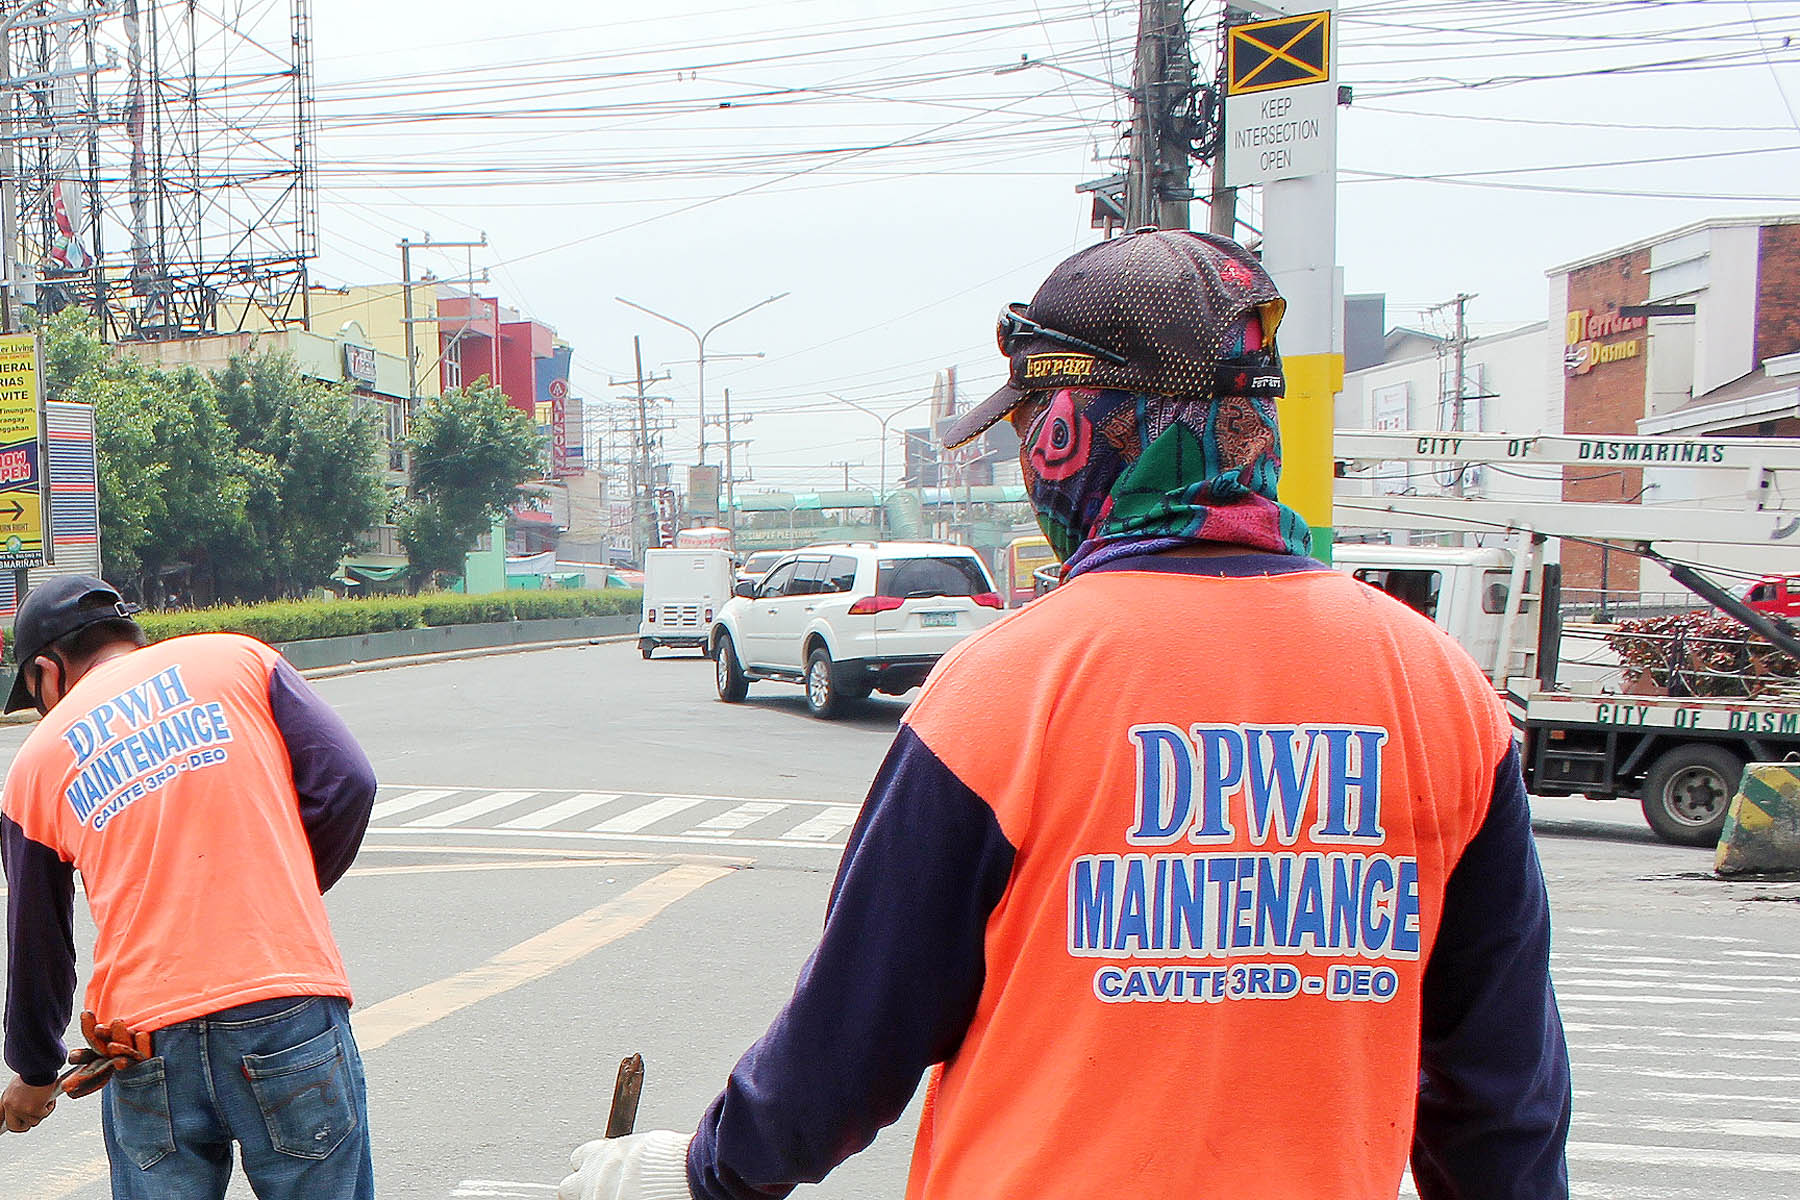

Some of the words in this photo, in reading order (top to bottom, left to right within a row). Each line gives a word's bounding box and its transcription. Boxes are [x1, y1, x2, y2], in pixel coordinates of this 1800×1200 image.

[1260, 96, 1292, 121] KEEP
[1233, 119, 1320, 150] INTERSECTION
[1259, 149, 1292, 172] OPEN
[10, 344, 34, 354] Living
[1591, 340, 1639, 366] Dasma
[1024, 352, 1096, 378] Ferrari
[1416, 437, 1463, 455] CITY
[1507, 440, 1532, 457] OF
[1578, 440, 1726, 463] DASMARIÑAS
[12, 522, 29, 532] RIGHT
[63, 666, 193, 767] DPWH
[1597, 703, 1648, 726] CITY
[1674, 708, 1701, 729] OF
[66, 703, 232, 824] MAINTENANCE
[93, 784, 144, 829] CAVITE
[146, 765, 177, 791] 3RD
[189, 749, 226, 768] DEO
[1128, 724, 1388, 844] DPWH
[1070, 854, 1421, 958] MAINTENANCE
[1097, 967, 1226, 1000] CAVITE
[1230, 966, 1298, 995] 3RD
[1332, 968, 1396, 996] DEO
